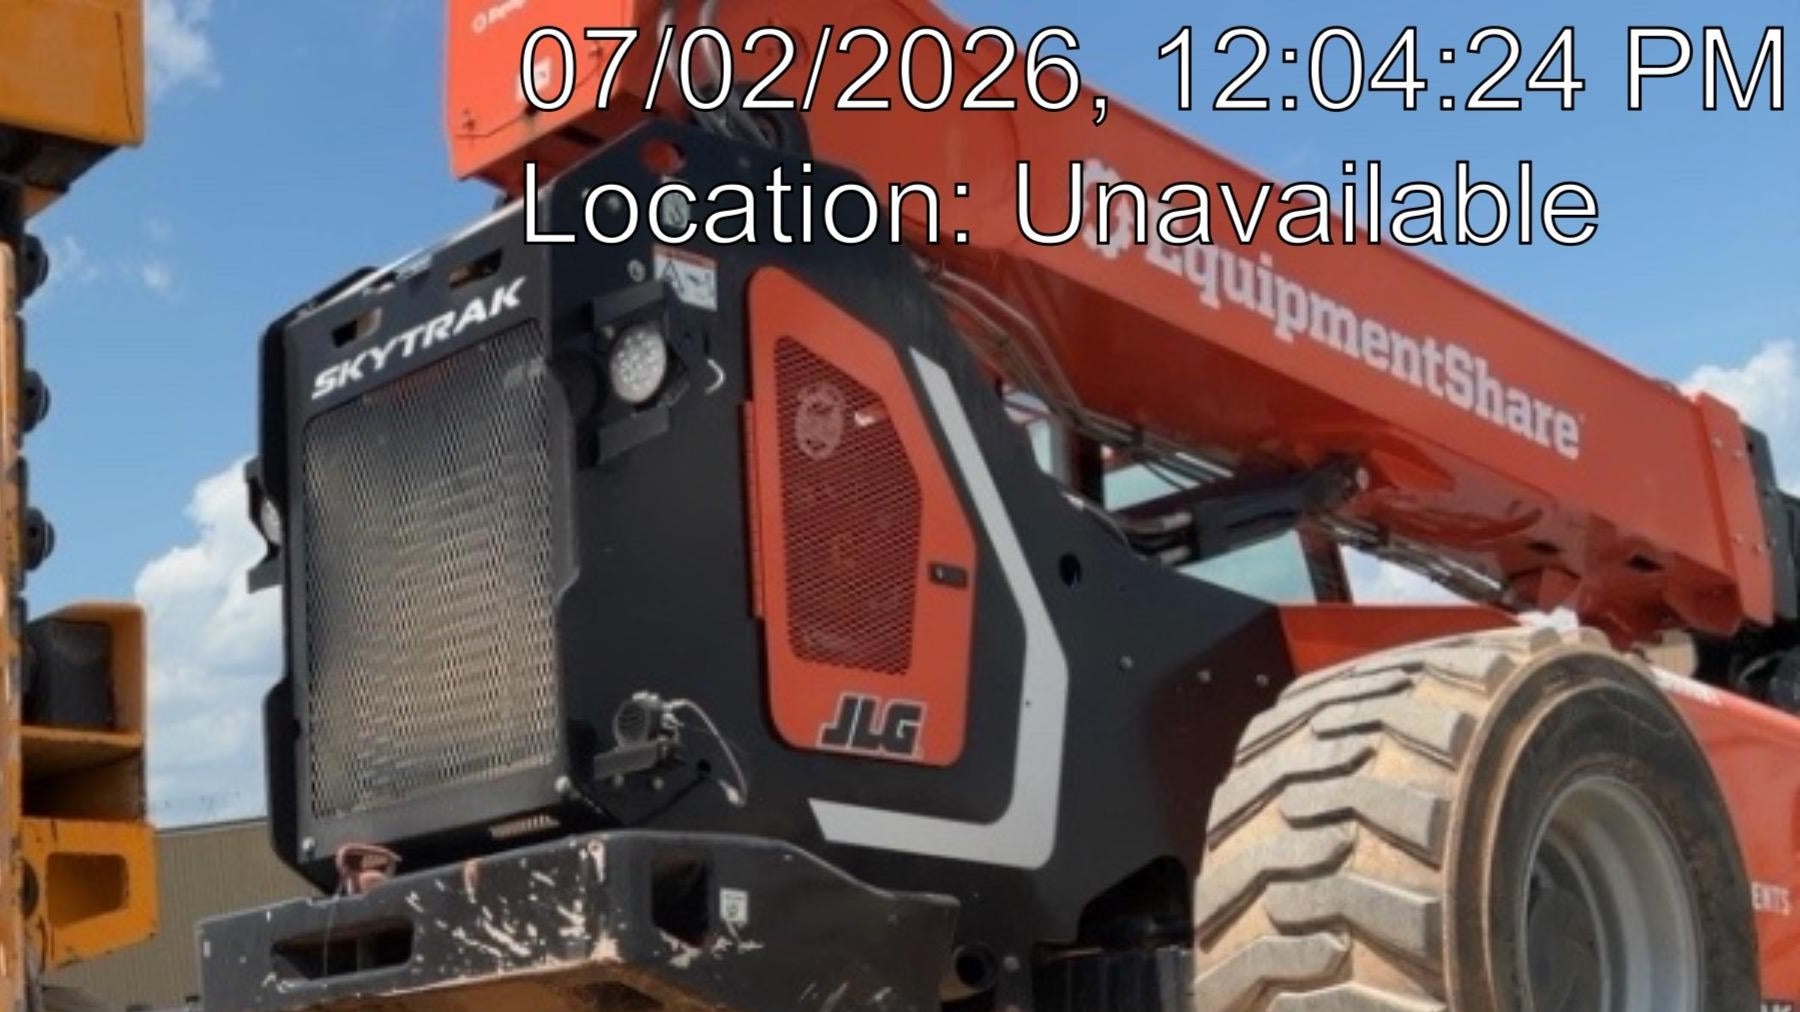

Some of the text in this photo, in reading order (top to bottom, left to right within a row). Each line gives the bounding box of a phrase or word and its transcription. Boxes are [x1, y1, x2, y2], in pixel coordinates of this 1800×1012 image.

[312, 276, 526, 400] SKYTRAK
[1144, 190, 1580, 460] EquipmentShare
[818, 694, 926, 758] JLG
[1752, 880, 1790, 915] ENTS
